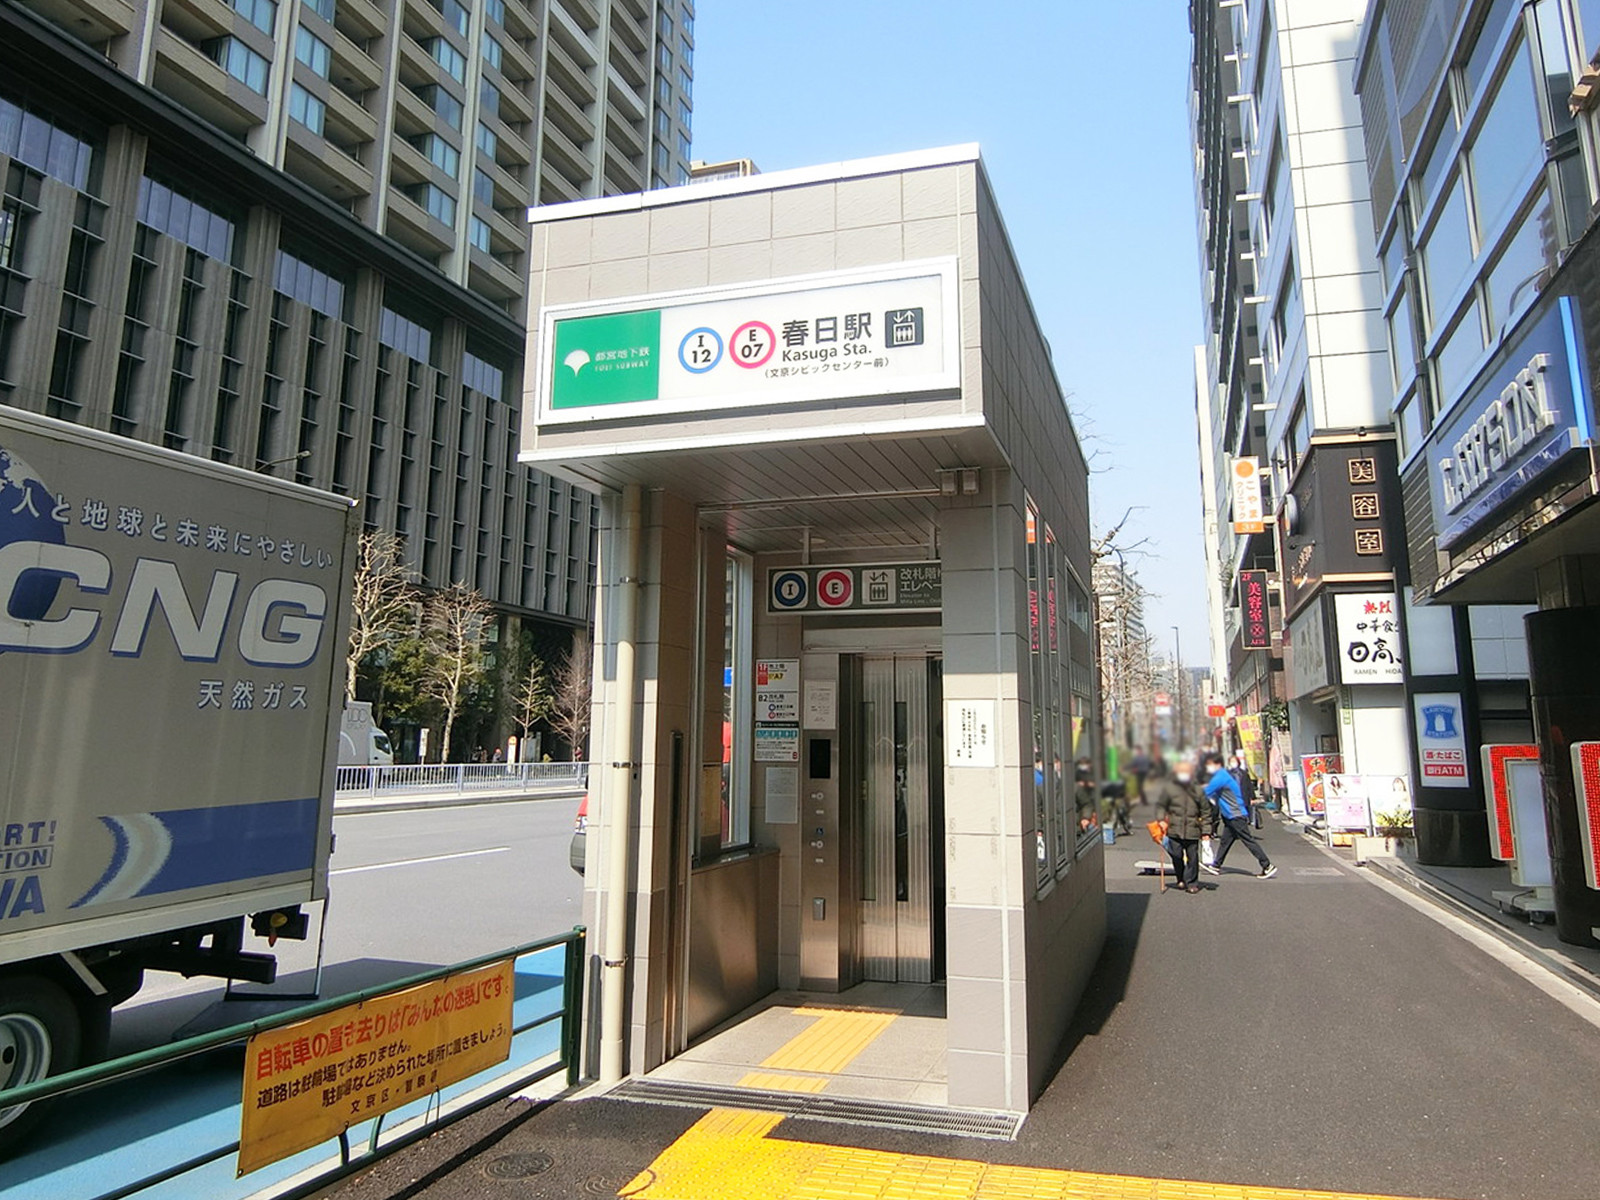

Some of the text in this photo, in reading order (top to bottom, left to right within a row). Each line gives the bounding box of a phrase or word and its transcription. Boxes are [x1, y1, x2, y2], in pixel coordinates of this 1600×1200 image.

[697, 335, 704, 347] I
[749, 329, 756, 342] E
[782, 312, 872, 347] 春日駅
[692, 349, 711, 363] 12
[741, 343, 764, 358] 07
[782, 343, 872, 363] Kasuga Sta.
[1438, 353, 1560, 516] LAWSON
[1350, 460, 1381, 552] 美容室
[12, 486, 334, 569] 人と地球と未来にやさしい
[831, 583, 838, 594] E
[1248, 582, 1262, 622] 美容室
[0, 540, 328, 668] CNG
[1347, 637, 1402, 664] 日高
[198, 680, 308, 710] 天然ガス
